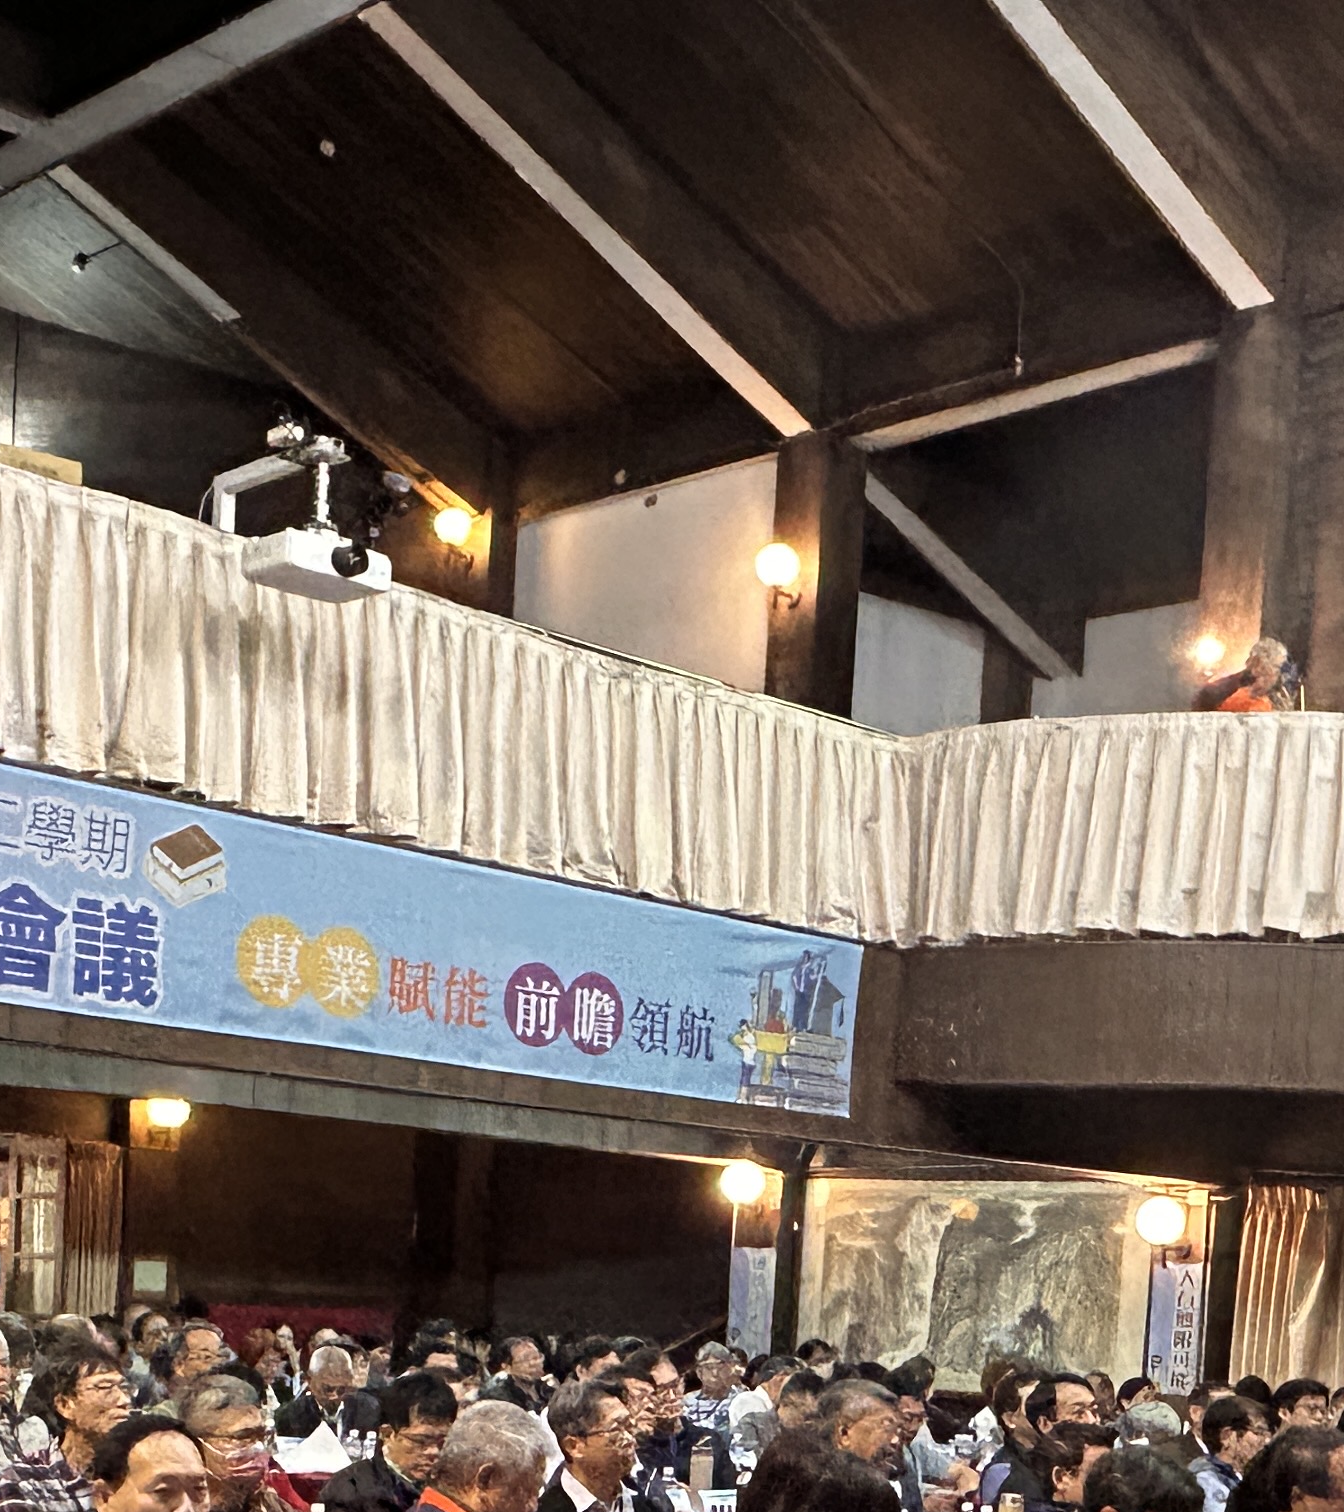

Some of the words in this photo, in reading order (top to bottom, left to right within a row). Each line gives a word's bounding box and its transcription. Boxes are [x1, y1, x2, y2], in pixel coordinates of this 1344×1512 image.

[255, 932, 714, 1063] 專業賦能前瞻領航
